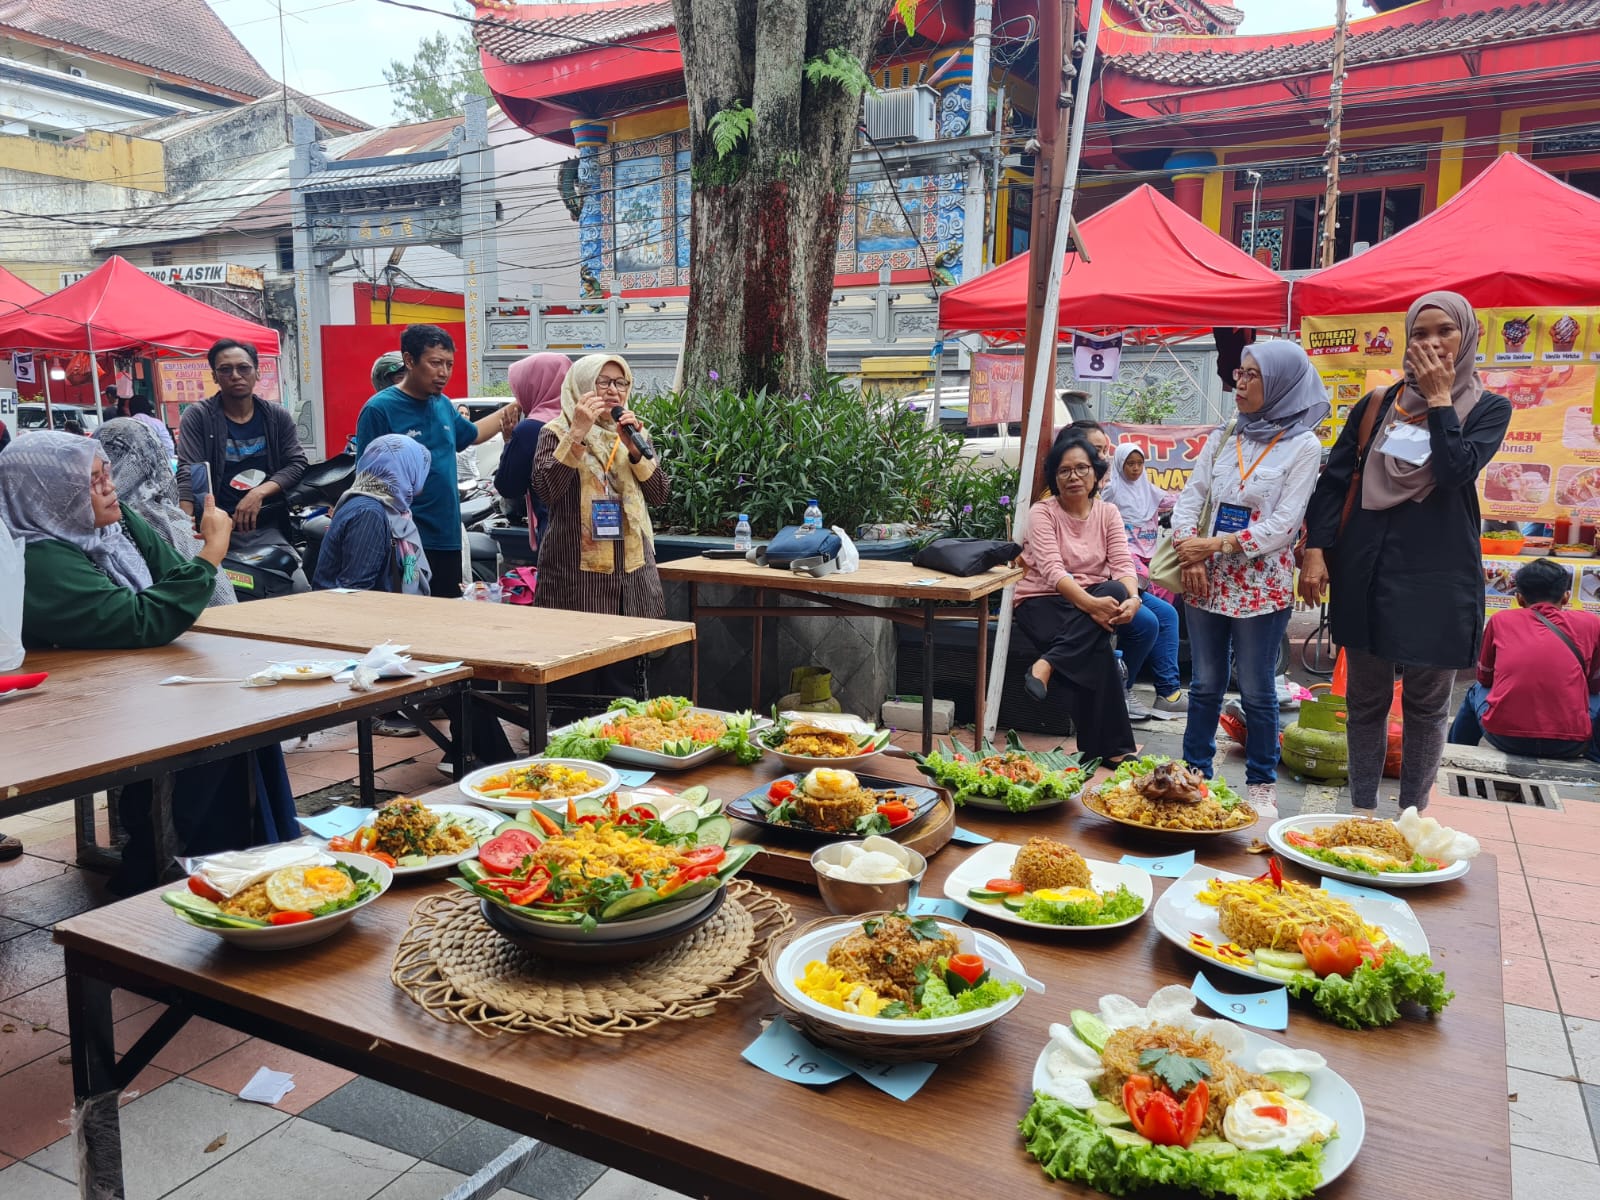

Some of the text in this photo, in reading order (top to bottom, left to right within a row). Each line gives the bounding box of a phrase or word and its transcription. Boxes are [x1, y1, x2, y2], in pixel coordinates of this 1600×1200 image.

[169, 265, 223, 281] PLASTIK
[1310, 329, 1355, 341] KOREAN
[1311, 337, 1354, 348] WAFFLE
[1312, 345, 1352, 355] ICE CREAM
[1090, 354, 1105, 372] 8
[18, 365, 29, 376] 9
[1151, 861, 1165, 871] 6
[783, 1052, 820, 1075] 16
